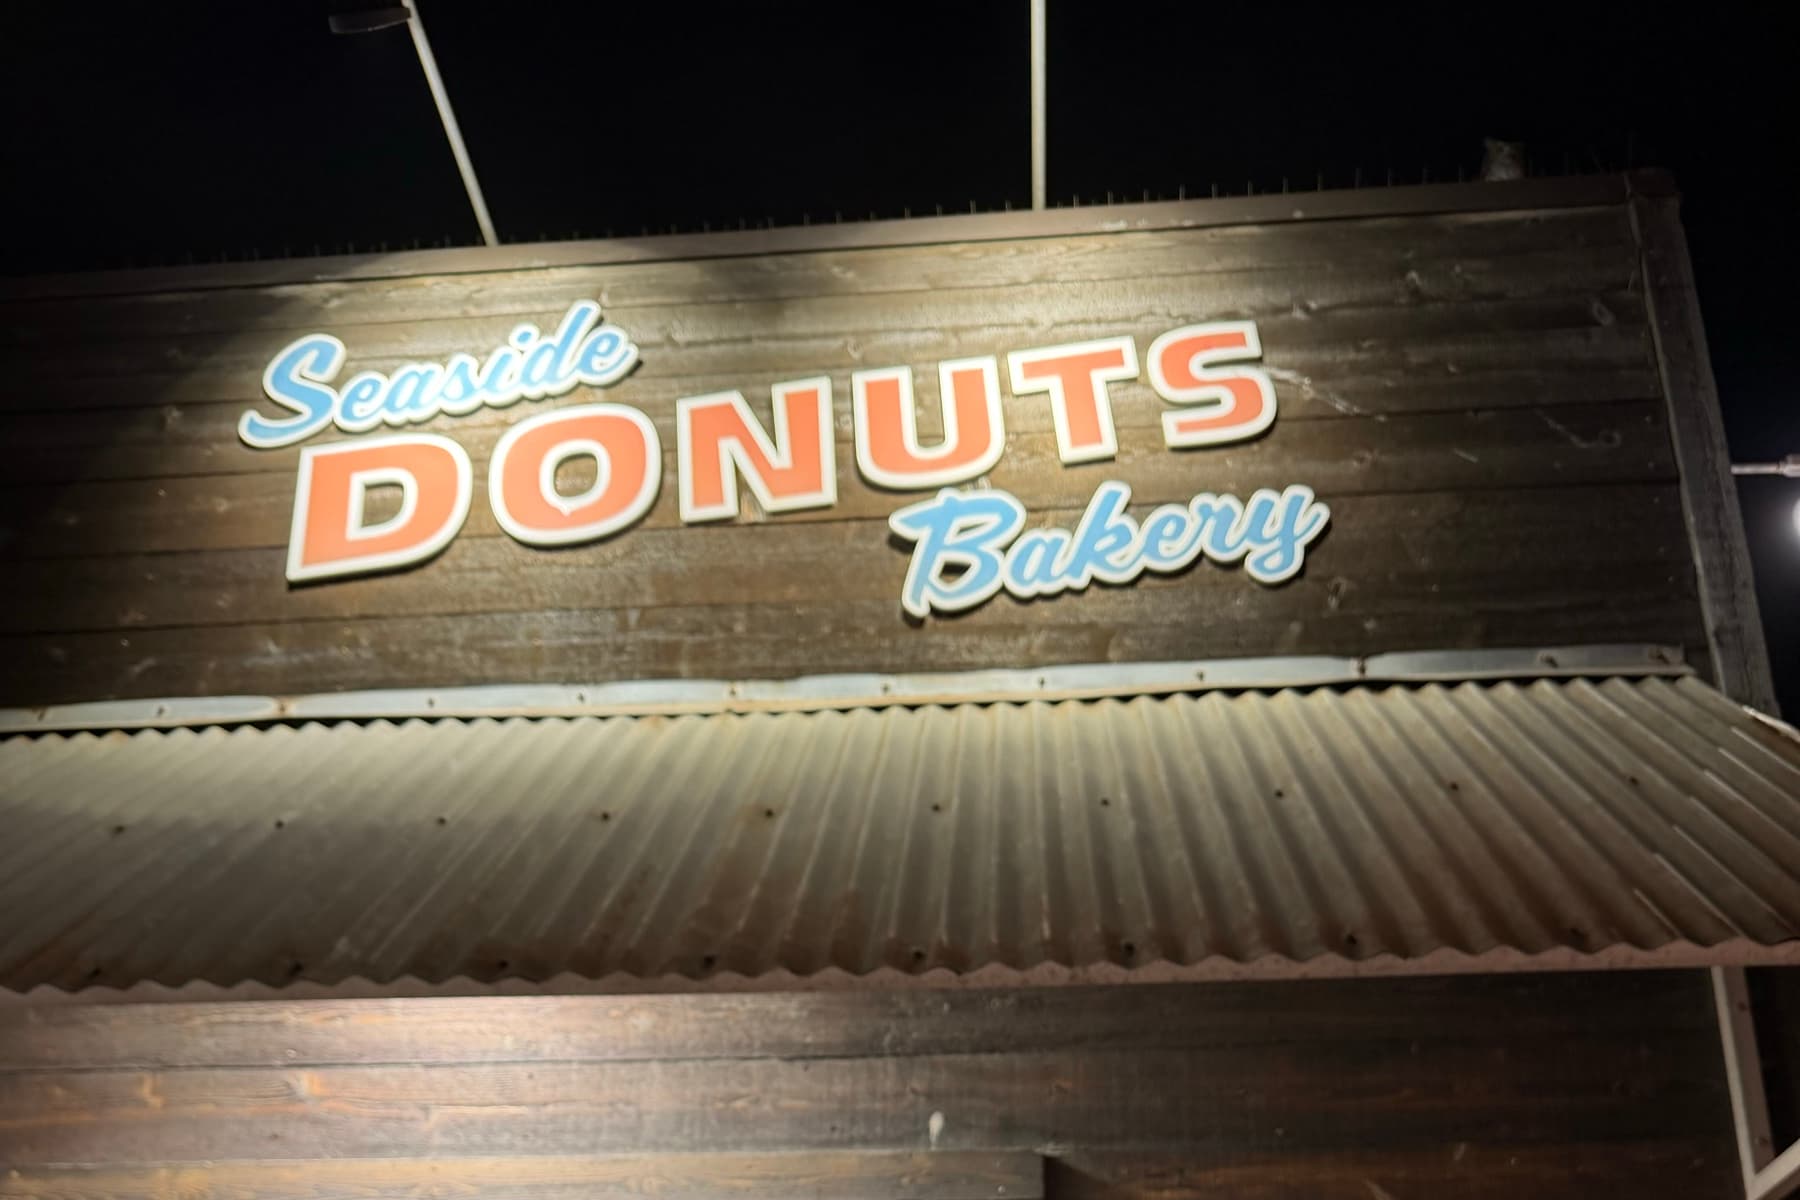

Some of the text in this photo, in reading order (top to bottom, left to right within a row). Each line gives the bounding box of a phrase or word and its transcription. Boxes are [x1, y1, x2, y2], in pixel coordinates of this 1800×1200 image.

[237, 300, 639, 449] Seaside
[285, 320, 1278, 584] DONUTS
[889, 481, 1331, 620] Bakery
